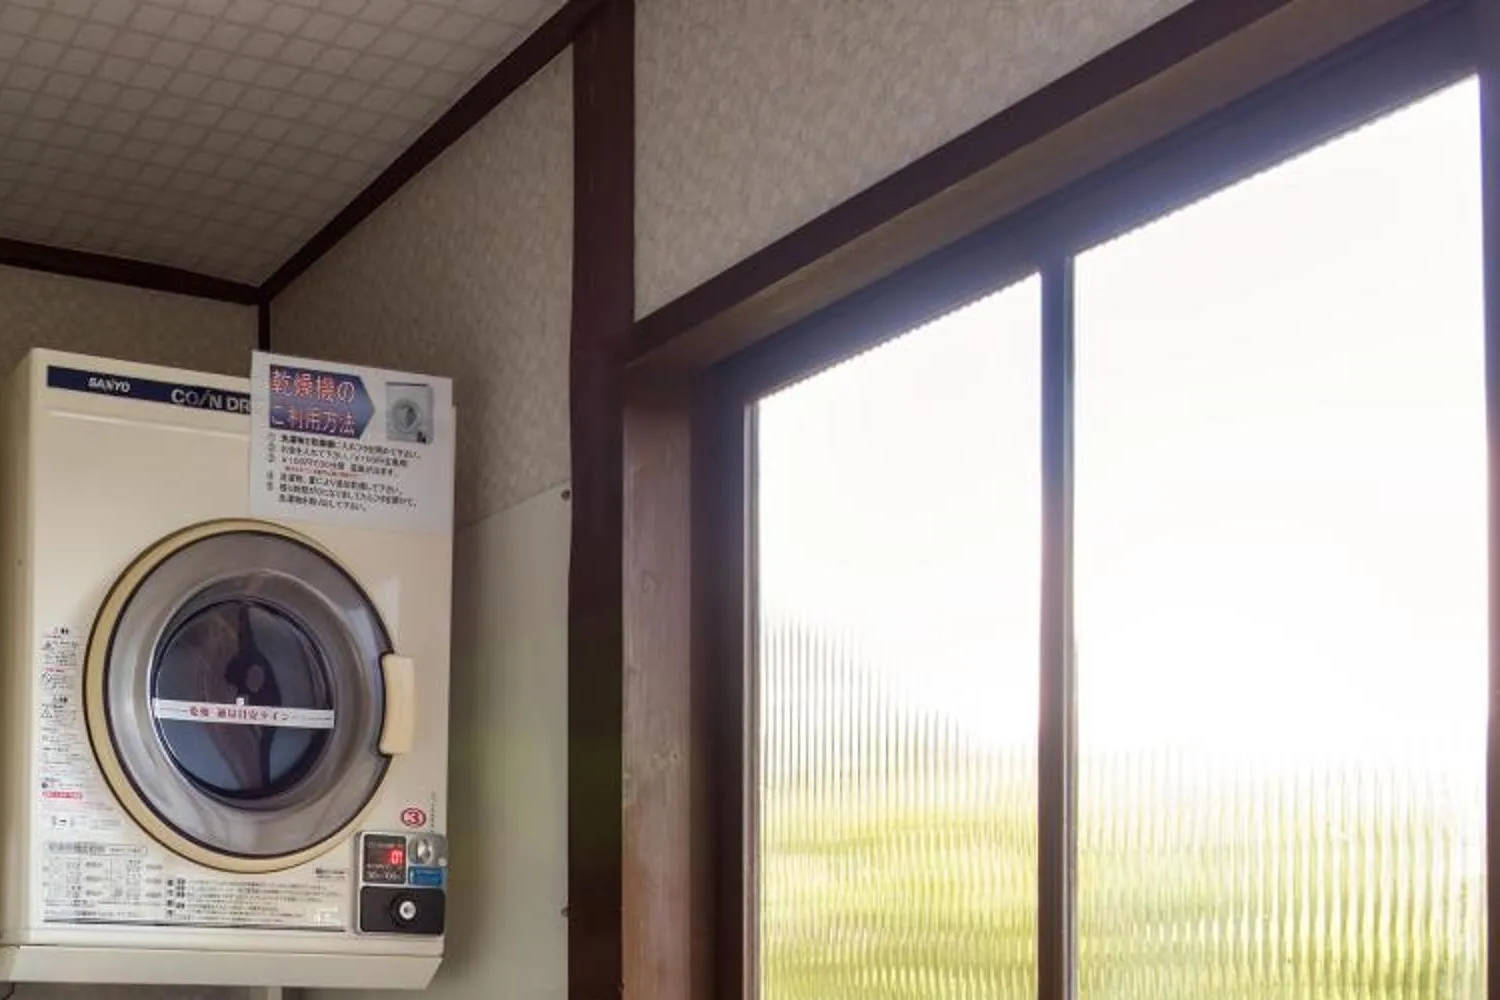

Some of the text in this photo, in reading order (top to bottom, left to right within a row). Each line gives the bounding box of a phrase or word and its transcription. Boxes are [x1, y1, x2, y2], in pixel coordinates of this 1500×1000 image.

[88, 377, 131, 393] SANYO
[271, 369, 356, 402] 乾燥機の
[271, 404, 356, 435] ご利用方法
